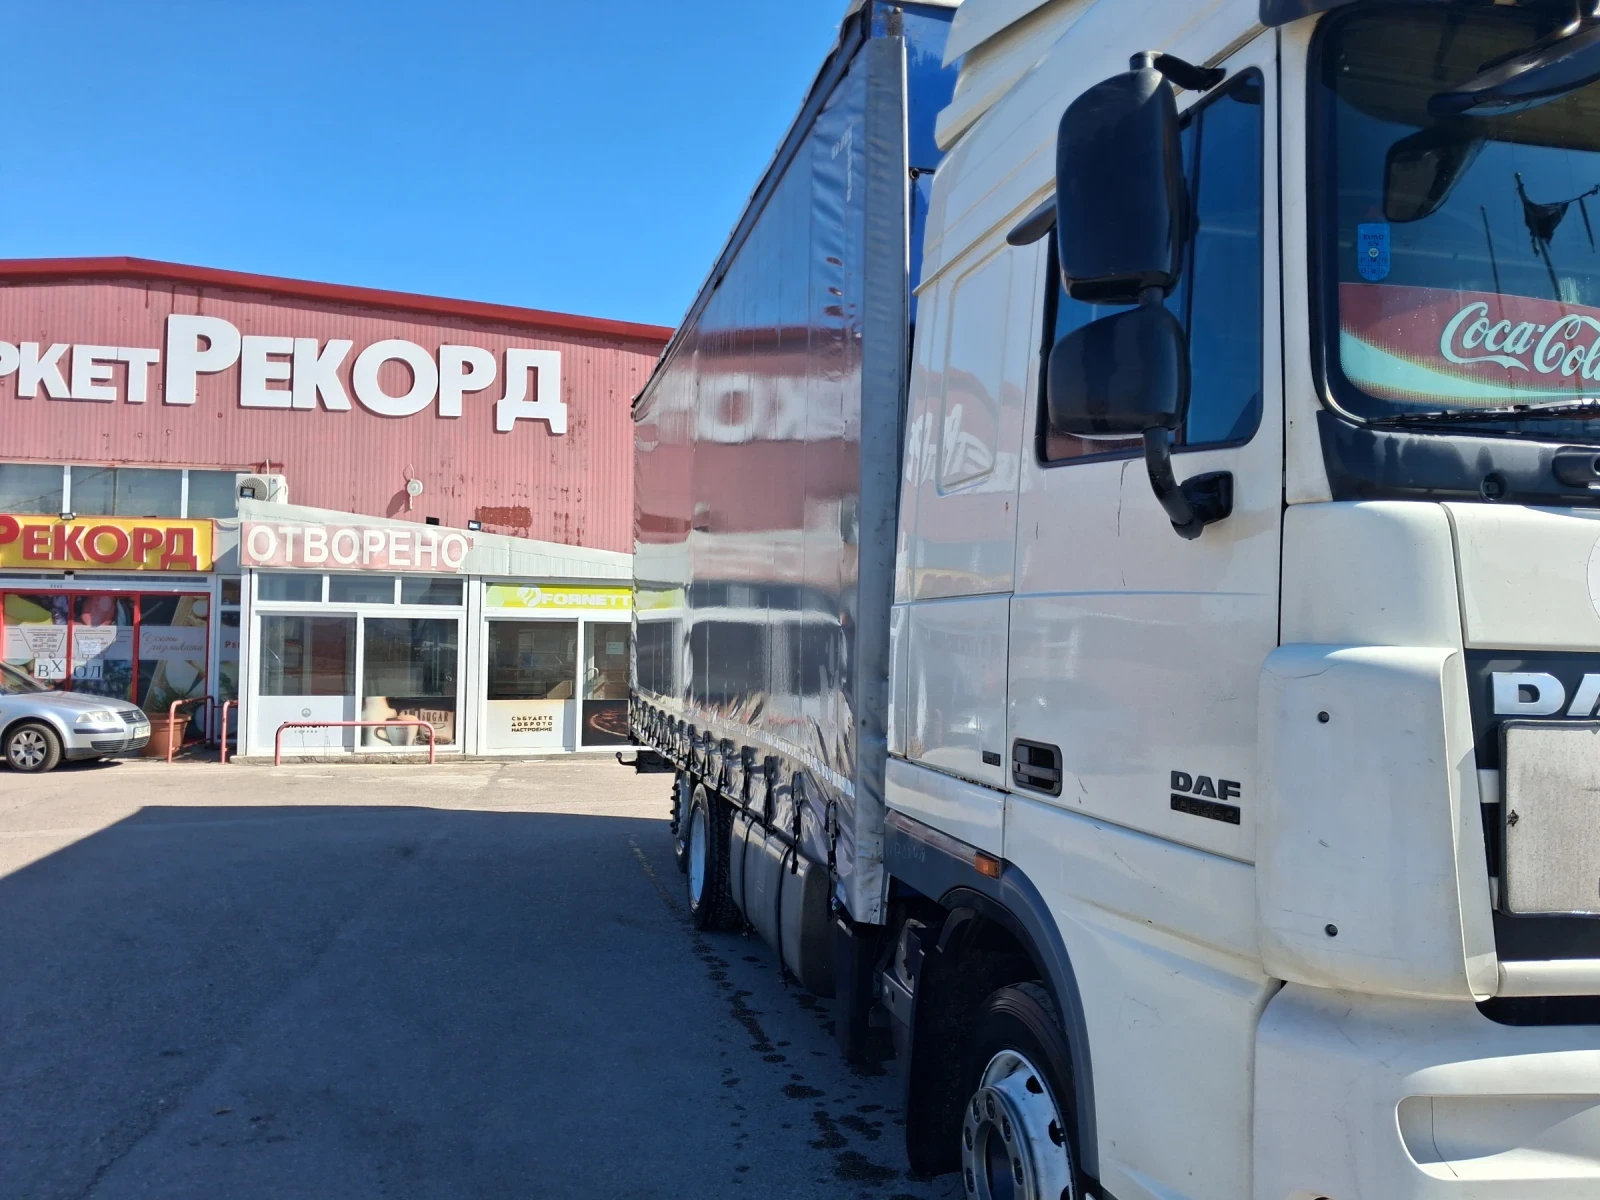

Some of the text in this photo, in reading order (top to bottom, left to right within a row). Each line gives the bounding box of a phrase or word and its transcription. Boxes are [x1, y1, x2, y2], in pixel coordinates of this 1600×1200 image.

[1440, 302, 1600, 381] Coca-Col
[165, 314, 567, 434] РЕКОРД
[247, 525, 469, 568] ОТВОРЕНО
[541, 592, 632, 606] FORNETT
[38, 659, 102, 678] ВХОД
[421, 711, 449, 722] SUGAR
[1171, 770, 1241, 800] DAF
